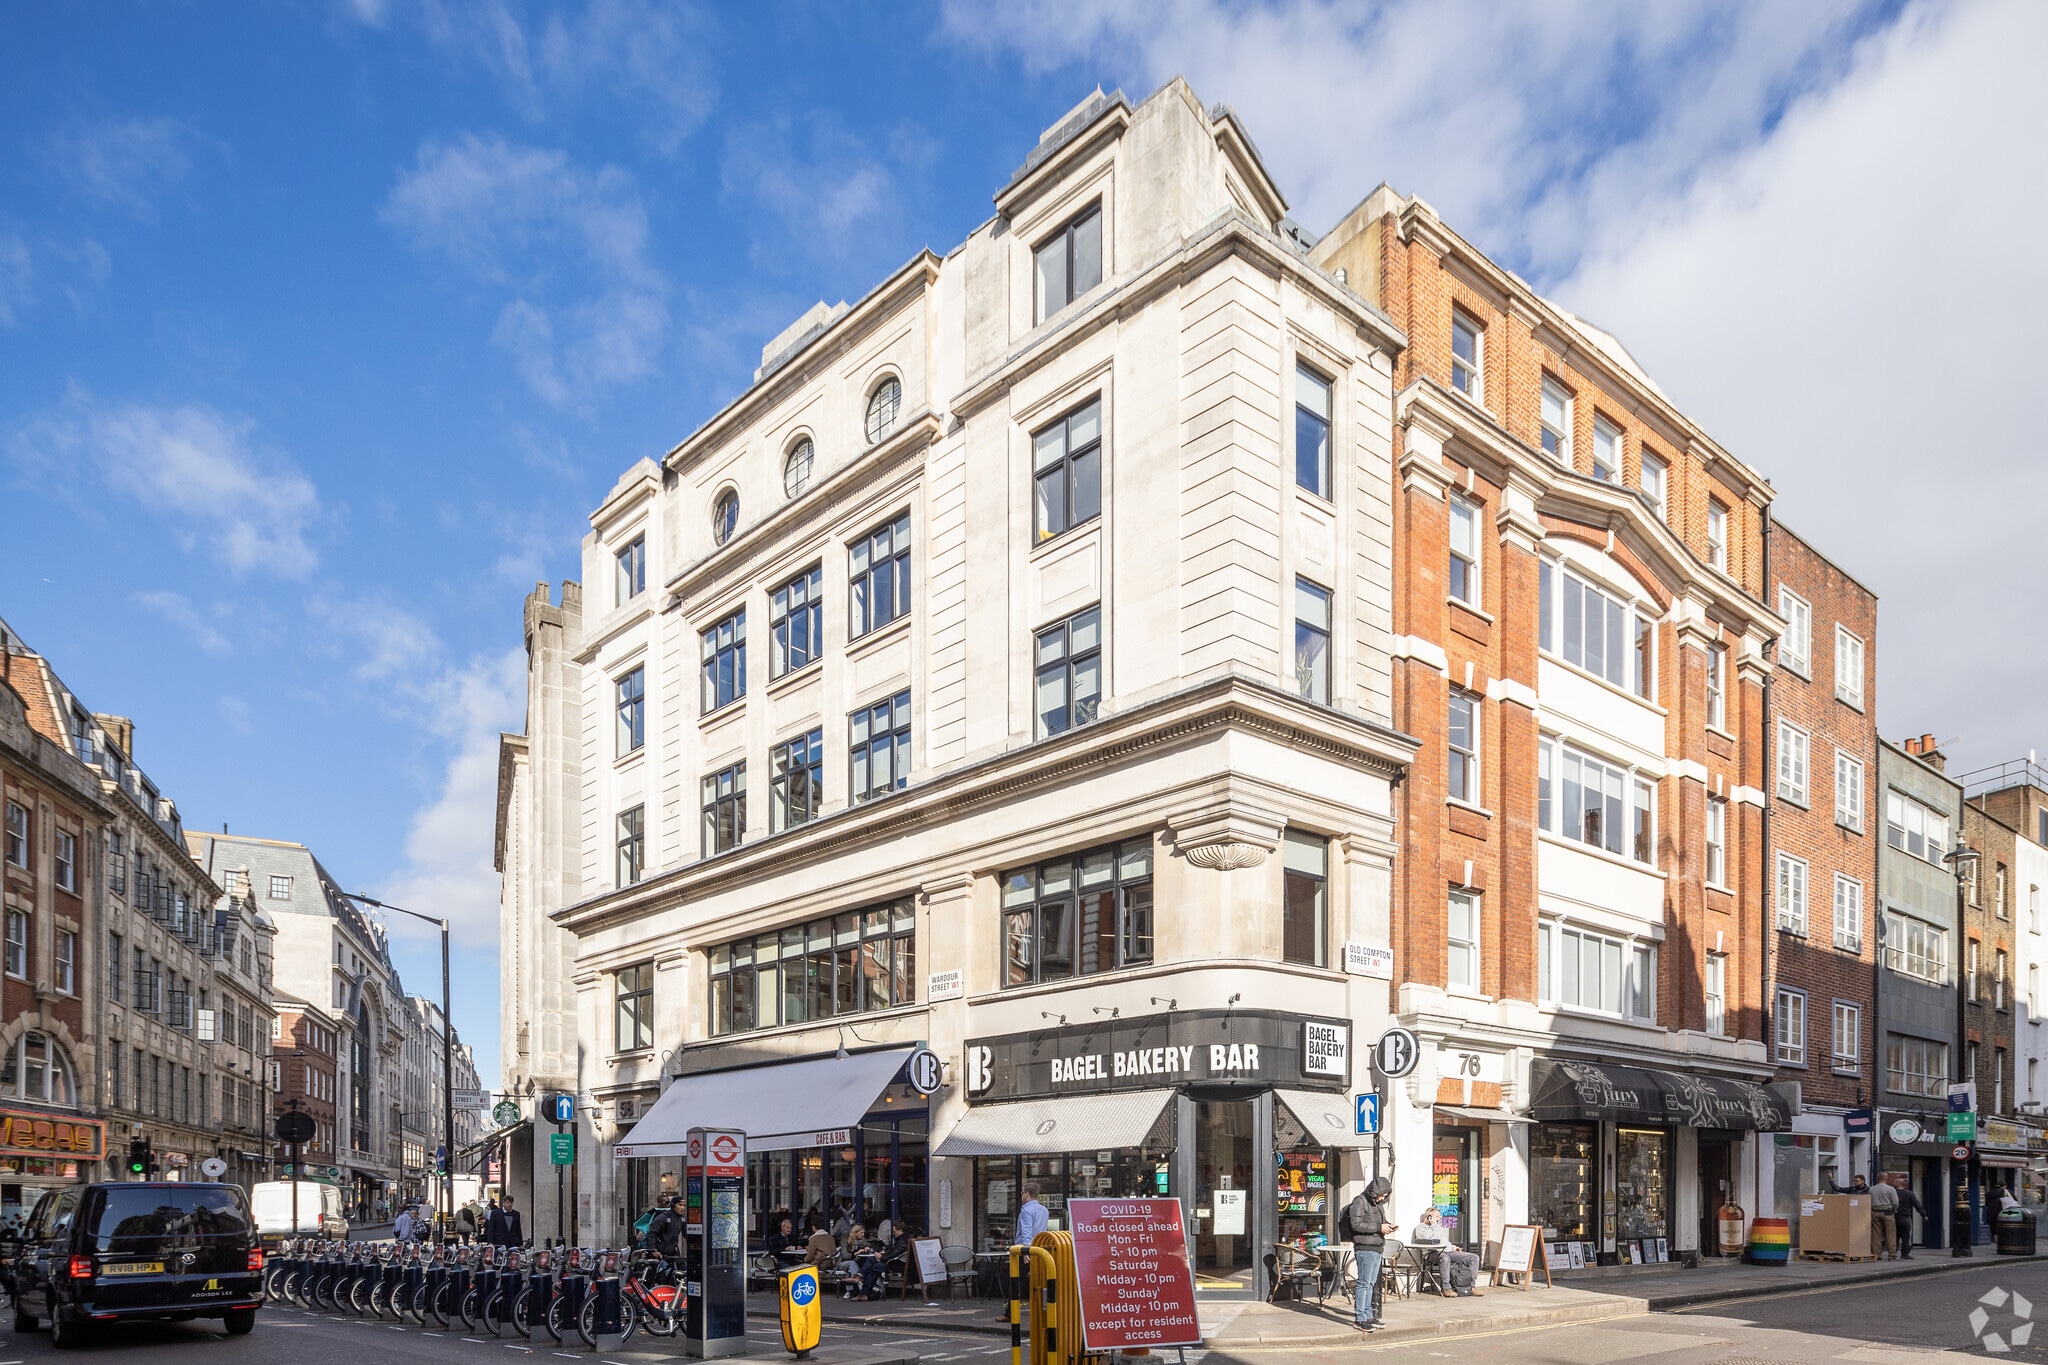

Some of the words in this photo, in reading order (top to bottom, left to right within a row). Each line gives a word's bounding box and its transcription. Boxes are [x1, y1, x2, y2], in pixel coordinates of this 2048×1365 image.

[1350, 944, 1361, 954] OLD
[1362, 947, 1390, 960] COMPTON
[1350, 954, 1370, 966] STREET
[1372, 959, 1380, 967] W1
[932, 972, 958, 984] WARDOUR
[931, 982, 950, 992] STREET
[951, 981, 960, 989] W1
[1308, 1026, 1337, 1042] BAGEL
[1308, 1041, 1344, 1058] BAKERY
[968, 1046, 992, 1091] B
[1052, 1054, 1108, 1082] BAGEL
[1114, 1045, 1194, 1078] BAKERY
[1210, 1044, 1260, 1070] BAR
[1308, 1055, 1326, 1070] BAR
[1459, 1054, 1480, 1076] 76
[620, 1101, 634, 1117] 58
[816, 1132, 828, 1145] CAFE
[830, 1132, 834, 1144] &
[835, 1131, 846, 1143] BAR
[1101, 1205, 1152, 1214] COVID-19
[1078, 1223, 1105, 1233] Road
[1109, 1222, 1144, 1232] closed
[1148, 1221, 1179, 1231] ahead
[1108, 1234, 1131, 1244] Mon
[1140, 1234, 1154, 1243] Fri
[1110, 1247, 1117, 1256] 5
[1127, 1247, 1139, 1256] 10
[1142, 1248, 1158, 1257] pm
[110, 1263, 134, 1273] RV18
[136, 1262, 157, 1272] HPA
[1110, 1261, 1158, 1270] Saturday
[1096, 1275, 1136, 1285] Midday
[1144, 1274, 1157, 1283] 10
[1159, 1274, 1175, 1284] pm
[1118, 1288, 1158, 1298] Sunday
[1101, 1303, 1140, 1314] Midday
[1148, 1301, 1161, 1311] 10
[1163, 1302, 1179, 1312] pm
[1089, 1319, 1126, 1330] except
[1130, 1318, 1146, 1327] for
[1150, 1315, 1193, 1326] resident
[1126, 1330, 1162, 1340] access
